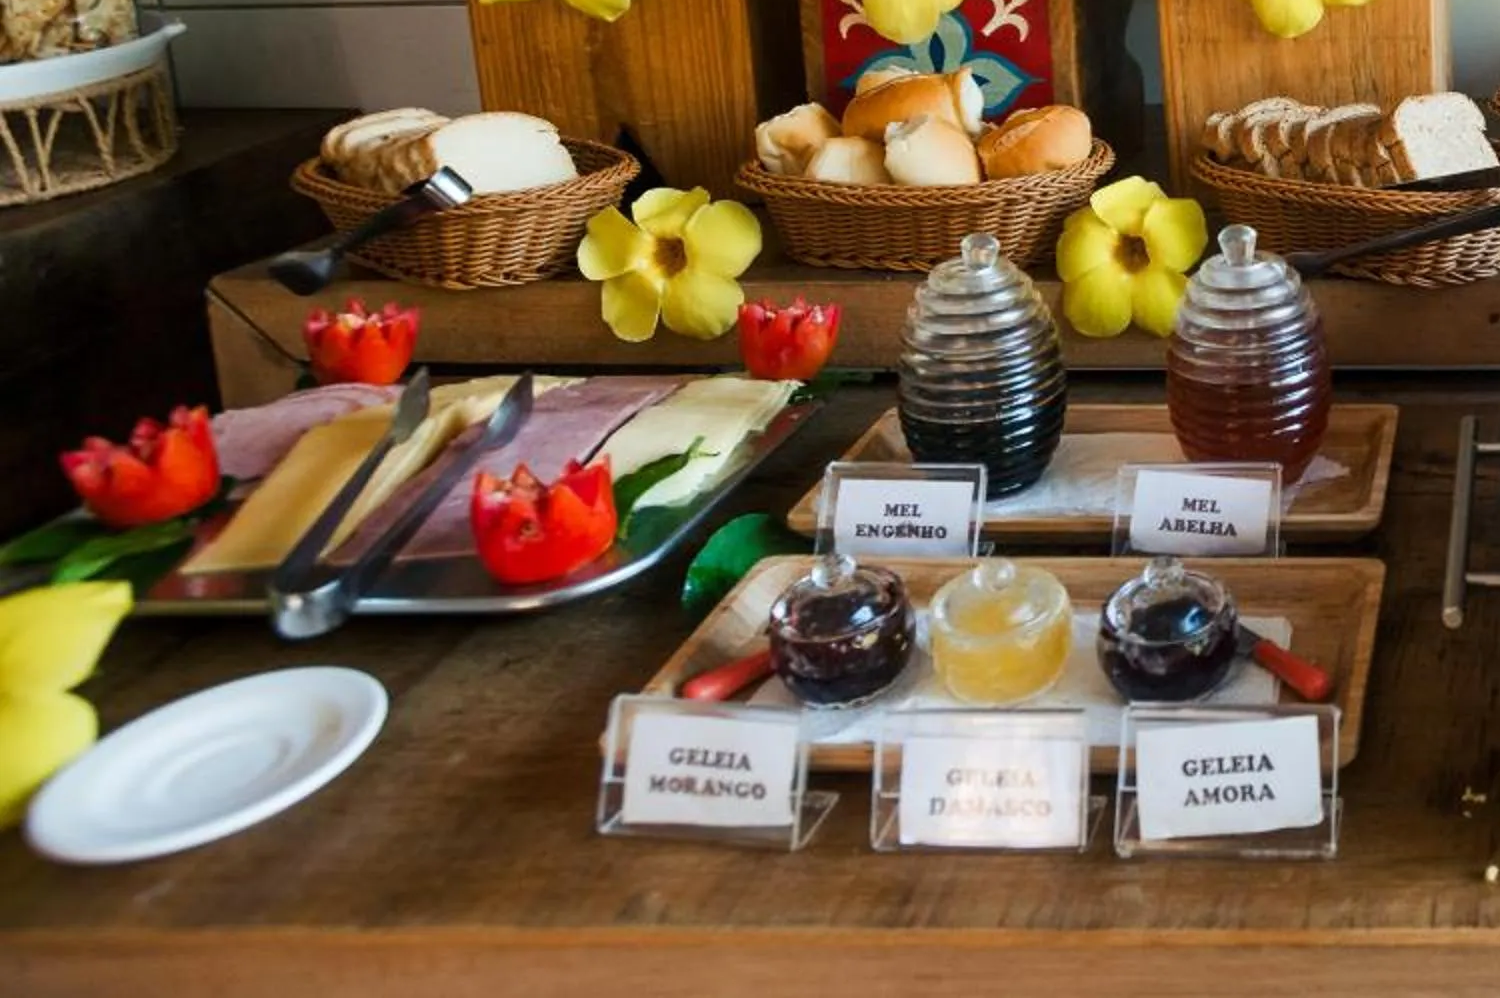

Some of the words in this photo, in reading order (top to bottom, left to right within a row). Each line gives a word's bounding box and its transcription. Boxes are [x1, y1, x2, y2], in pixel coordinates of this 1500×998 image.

[884, 503, 922, 517] MEL
[1182, 497, 1221, 513] MEL
[855, 523, 947, 539] ENGENHO
[1158, 517, 1238, 537] ABELHA
[669, 748, 752, 771] GELEIA
[1182, 753, 1274, 777] GELEIA
[649, 774, 767, 800] MORANGO
[1184, 783, 1275, 807] AMORA
